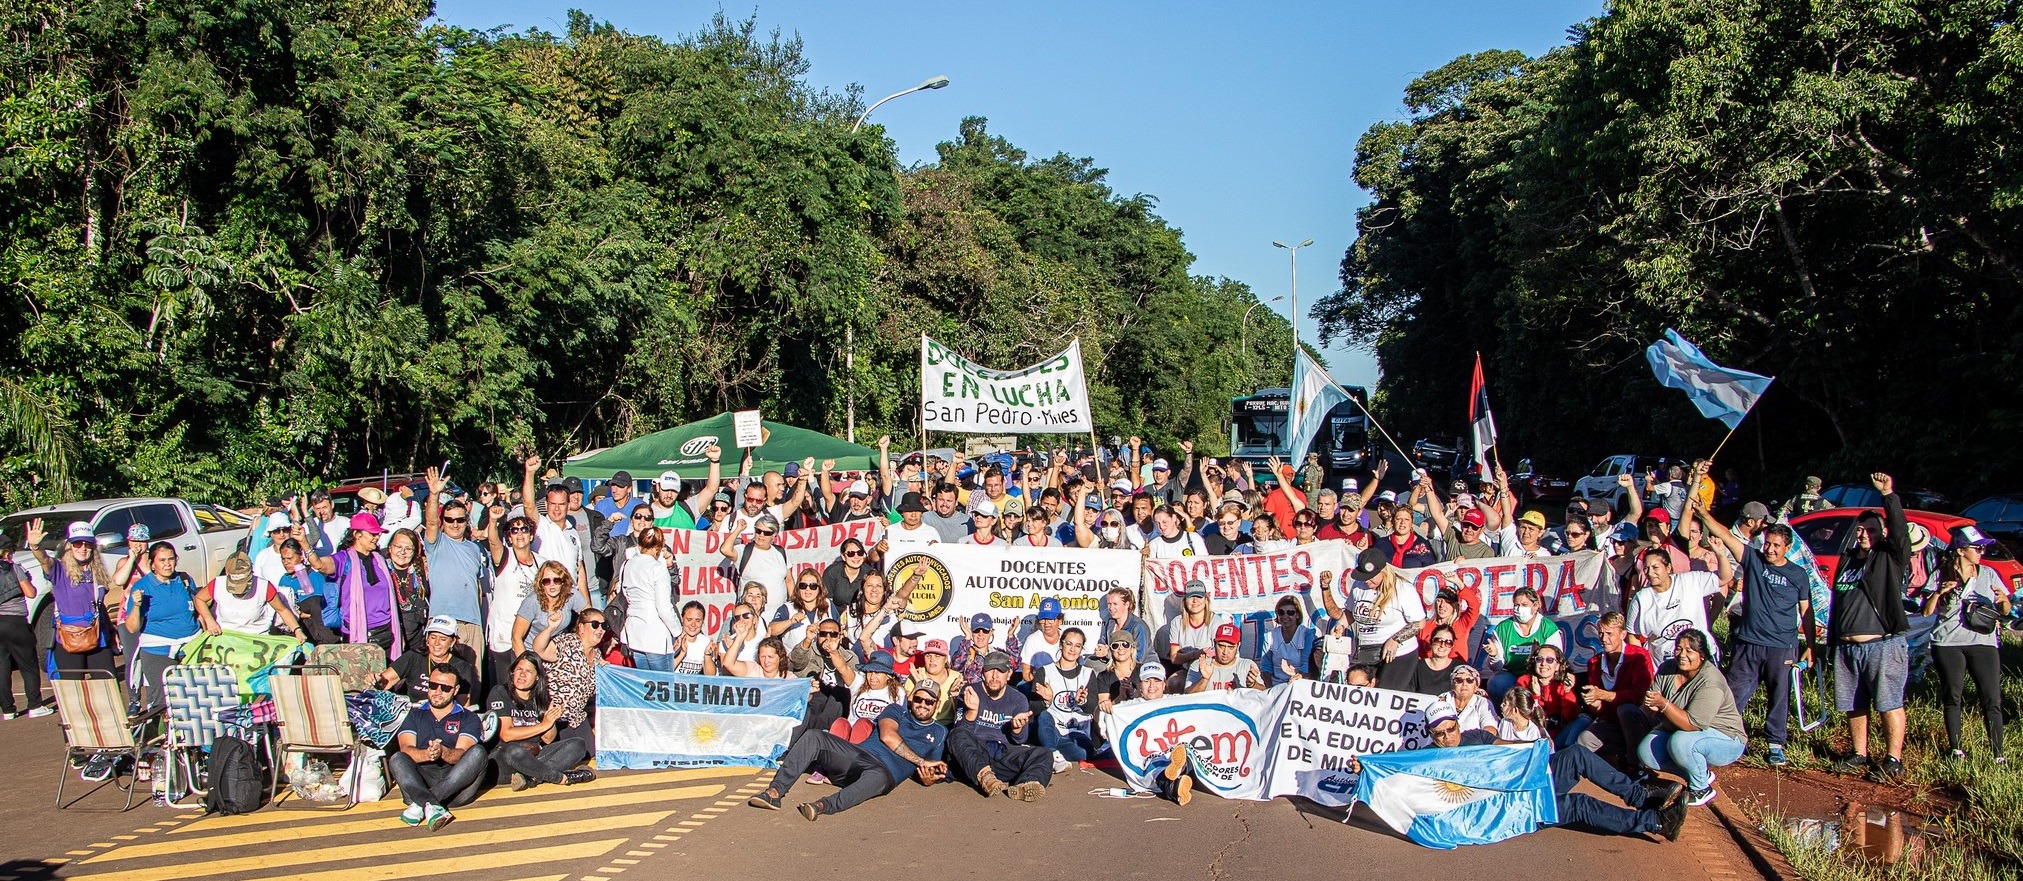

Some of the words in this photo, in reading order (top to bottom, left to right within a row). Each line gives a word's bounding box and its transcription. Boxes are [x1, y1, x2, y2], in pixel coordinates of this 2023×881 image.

[942, 372, 980, 400] EN
[990, 378, 1071, 408] LUCHA
[924, 400, 965, 423] San
[976, 402, 1033, 426] Pedro
[662, 528, 690, 554] N
[831, 521, 876, 548] DEL
[1000, 560, 1087, 575] DOCENTES
[1147, 551, 1314, 600] DOCENTES
[965, 575, 1120, 592] AUTOCONVOCADOS
[912, 592, 936, 600] LUCHA
[989, 590, 1024, 608] San
[1029, 592, 1100, 610] Aonio
[644, 681, 670, 703] 25
[674, 682, 699, 704] DE
[702, 684, 761, 708] MAYO
[1311, 681, 1379, 708] UNIÓN
[1390, 694, 1419, 714] DE
[1298, 724, 1320, 744] LA
[1287, 745, 1312, 764] DE
